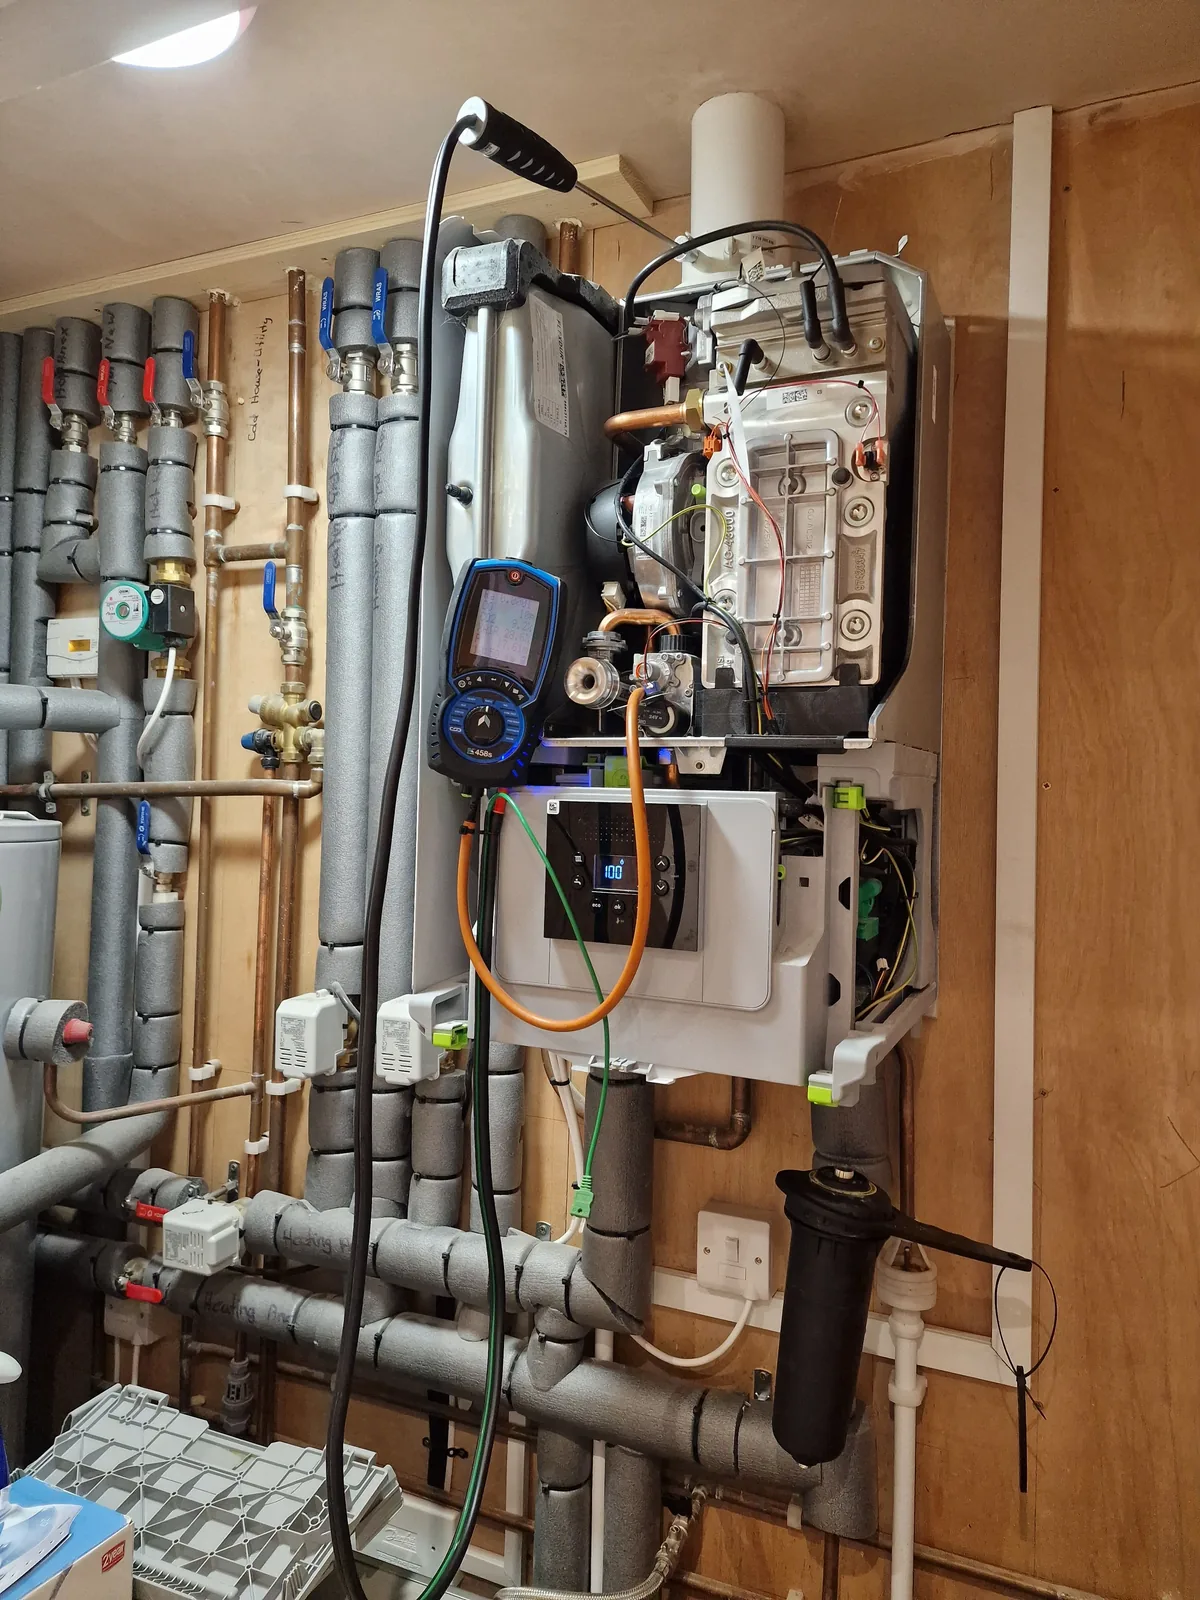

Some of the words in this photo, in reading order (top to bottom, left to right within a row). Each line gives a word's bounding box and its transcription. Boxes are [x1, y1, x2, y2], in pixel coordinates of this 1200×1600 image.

[321, 291, 329, 312] WRAS
[475, 748, 493, 758] 458s
[604, 865, 623, 879] 100
